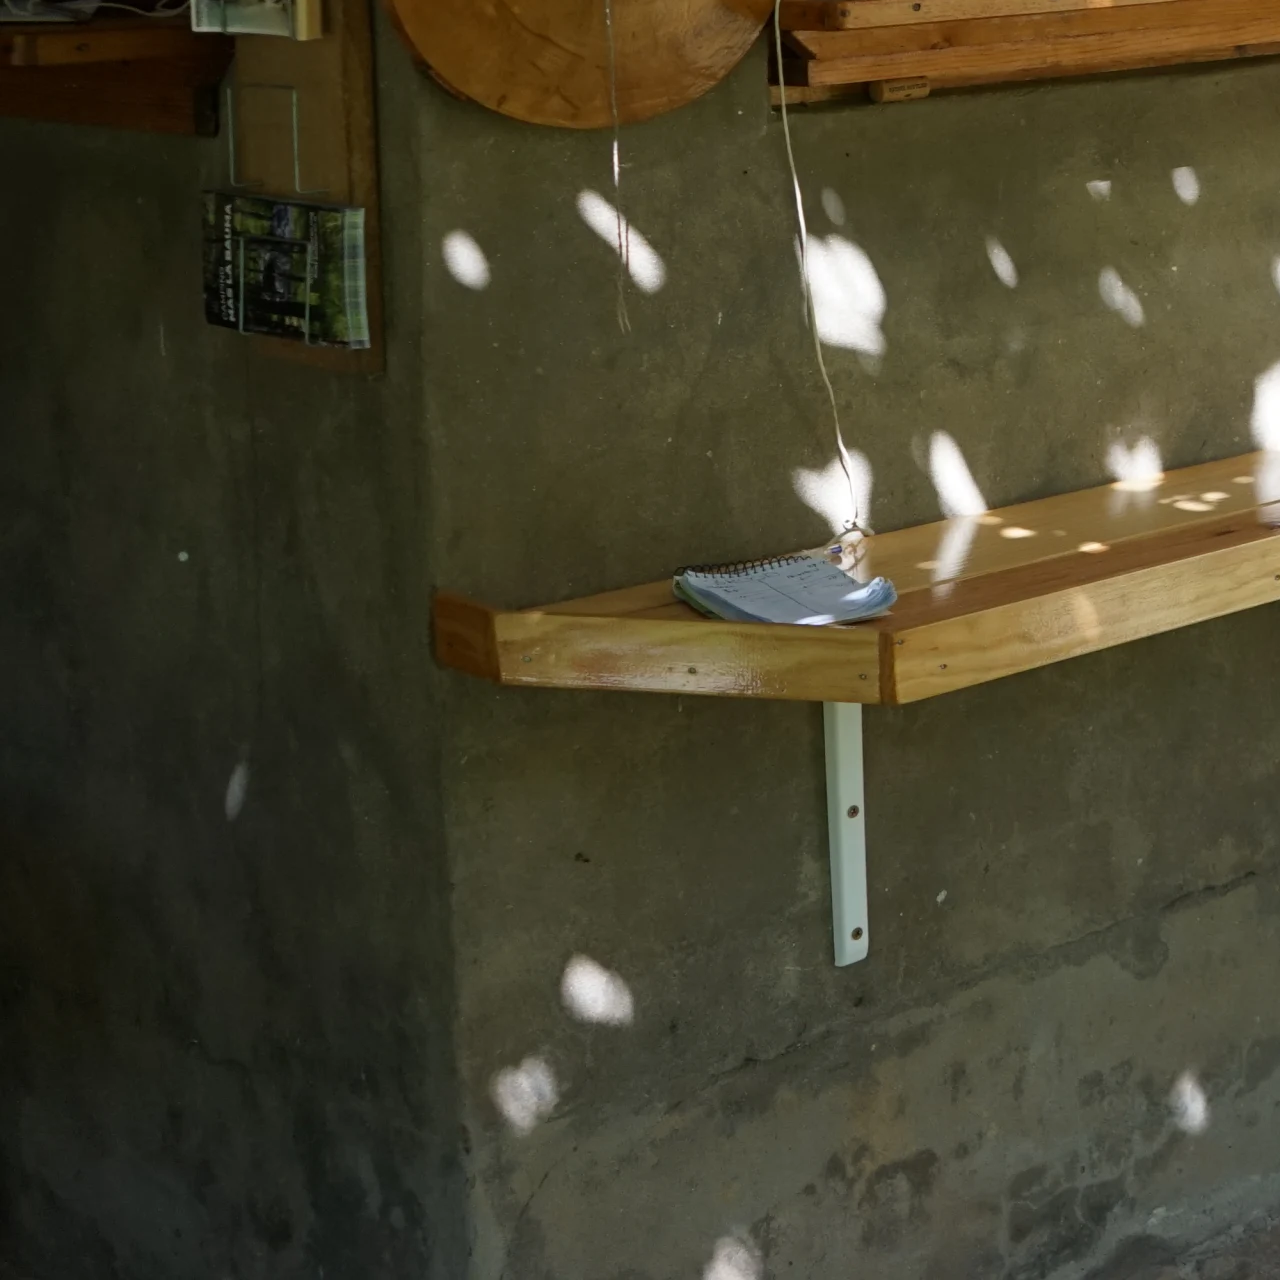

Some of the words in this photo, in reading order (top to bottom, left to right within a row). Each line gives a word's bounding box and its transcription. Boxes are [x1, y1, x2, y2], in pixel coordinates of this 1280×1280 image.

[224, 204, 232, 261] BAUMA
[225, 264, 232, 284] LA
[226, 287, 236, 322] MAS
